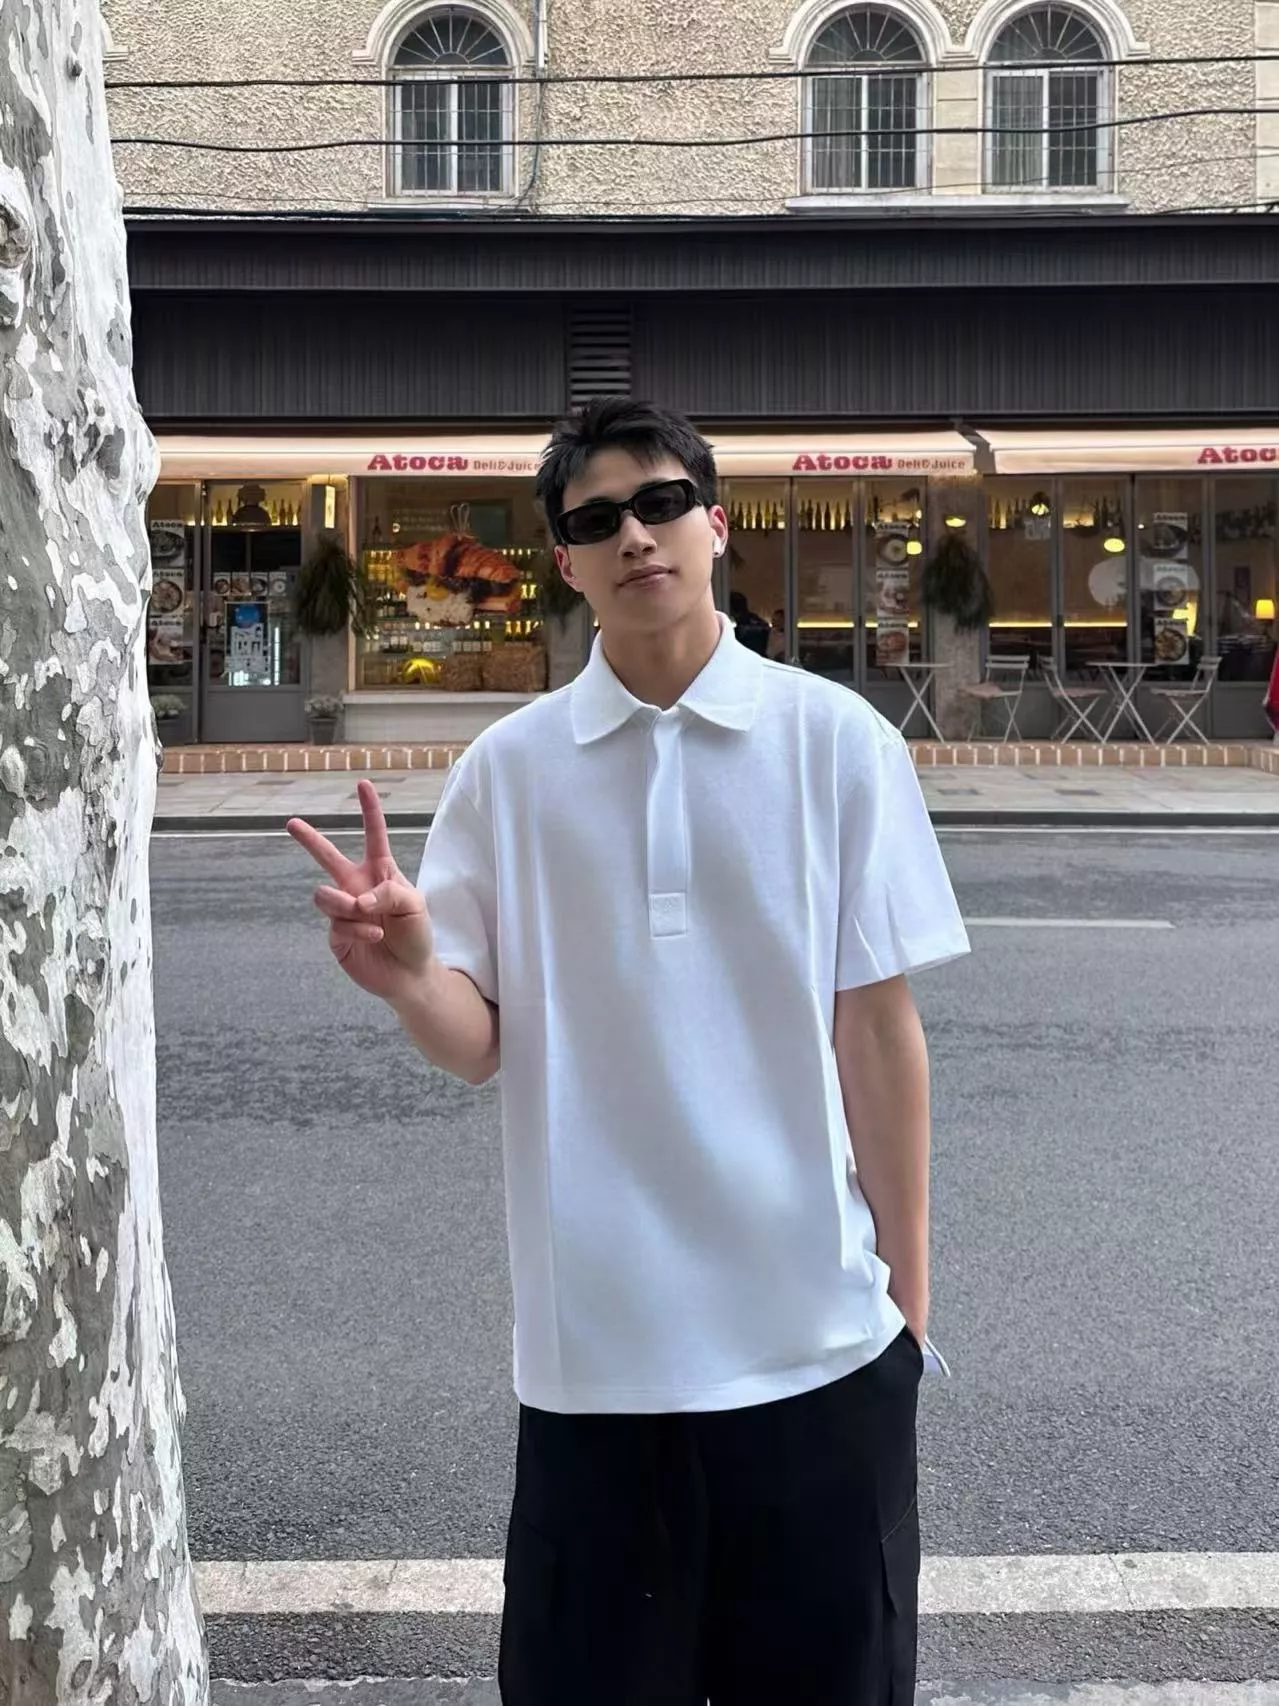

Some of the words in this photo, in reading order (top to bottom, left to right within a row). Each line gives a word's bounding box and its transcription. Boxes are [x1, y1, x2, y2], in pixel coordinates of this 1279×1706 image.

[367, 453, 469, 471] Atoca
[792, 453, 893, 471] Atoca
[1198, 446, 1279, 464] Atoc
